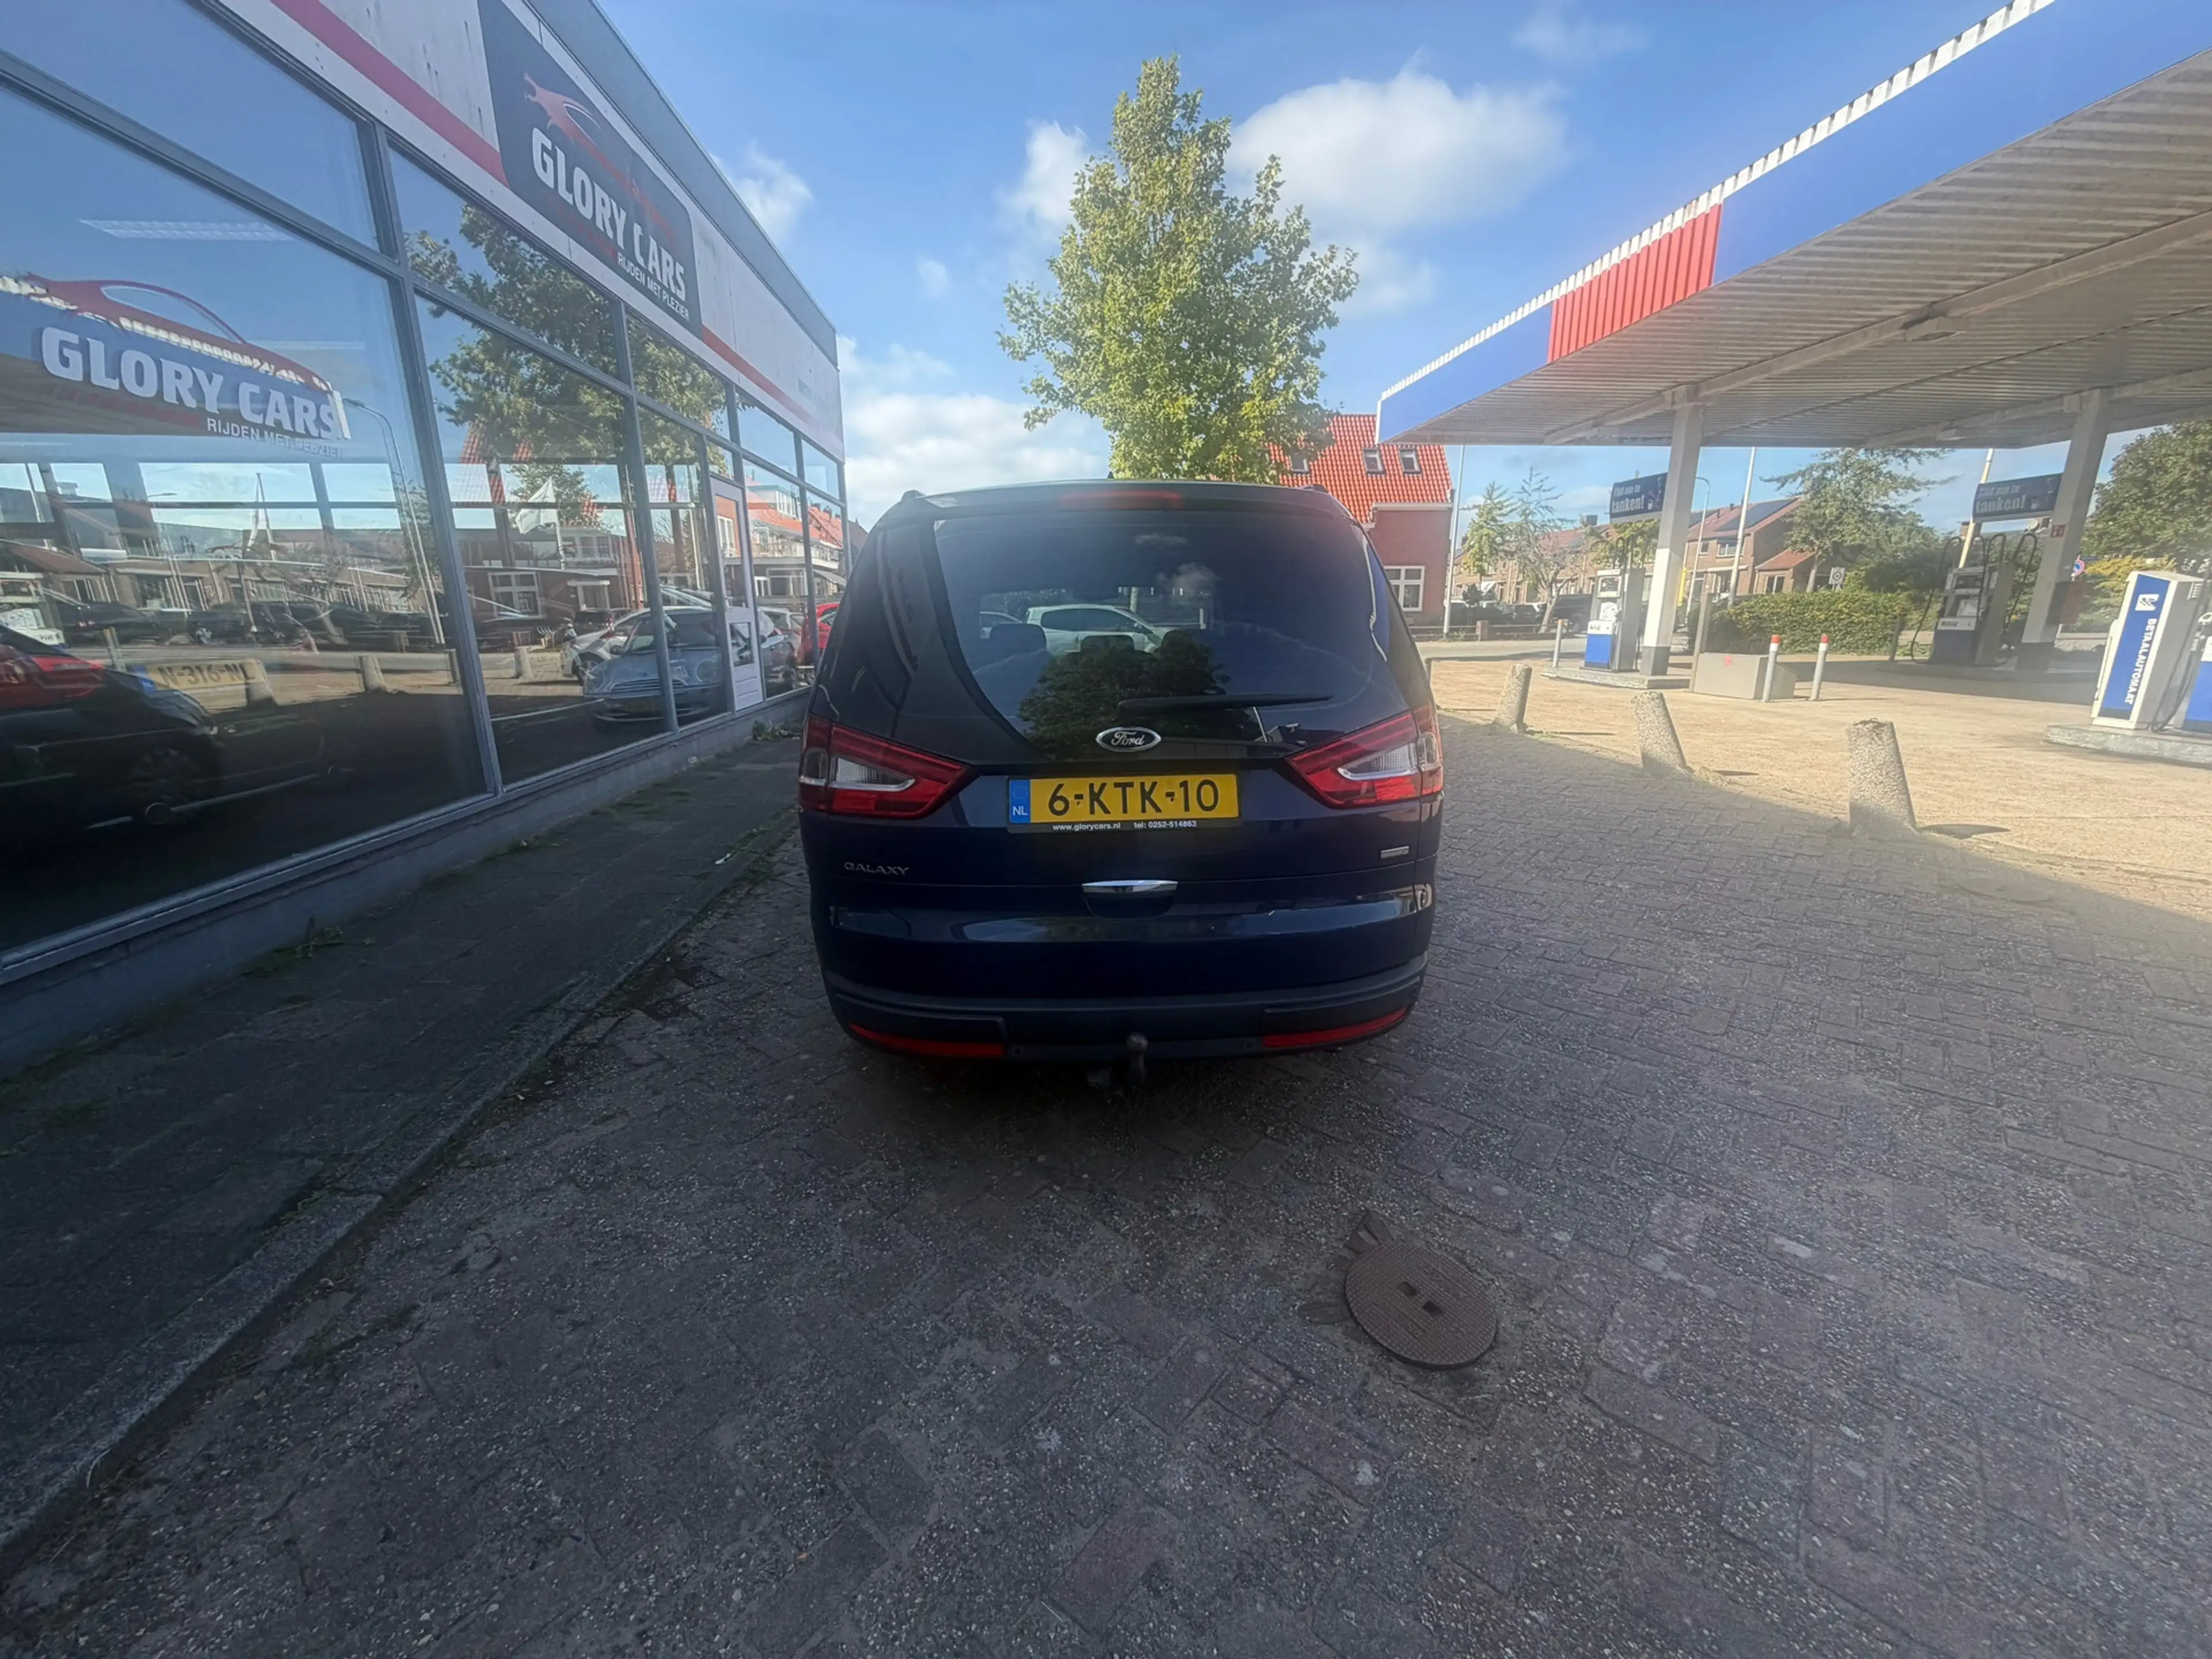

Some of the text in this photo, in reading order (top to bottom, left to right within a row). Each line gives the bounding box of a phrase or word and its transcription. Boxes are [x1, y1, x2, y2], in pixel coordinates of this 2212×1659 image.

[532, 127, 685, 301] GLORY CARS
[618, 251, 690, 322] RIJDEN MET PLEZIER
[42, 327, 343, 441] GLORY CARS
[207, 417, 260, 442] RIJDEN
[263, 430, 291, 448] MET
[1611, 494, 1645, 514] tanken!
[1975, 494, 2027, 514] tanken!
[2124, 618, 2157, 704] BETAALAUTOMAAT
[1111, 731, 1145, 746] Ford
[1012, 778, 1219, 816] NL 6-KTK-10
[1052, 822, 1120, 832] www.glorycars.nl
[843, 861, 909, 876] GALAXY
